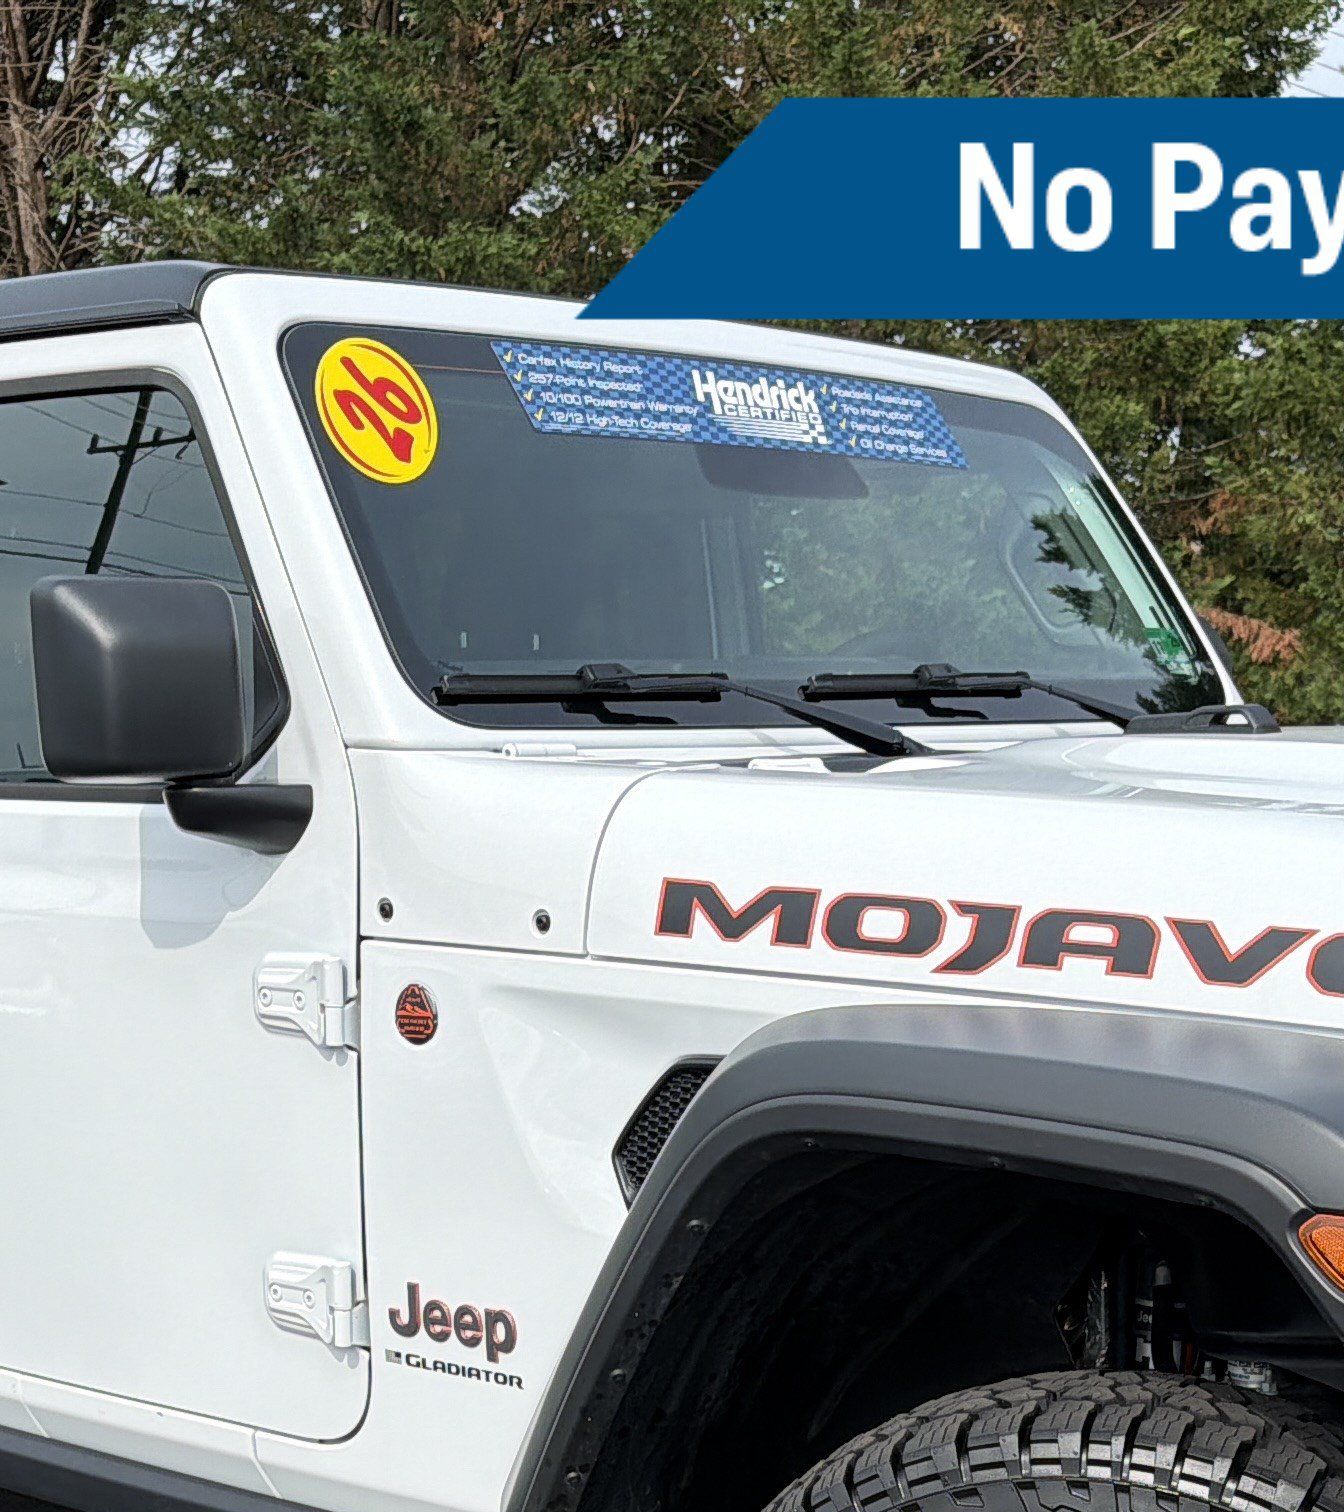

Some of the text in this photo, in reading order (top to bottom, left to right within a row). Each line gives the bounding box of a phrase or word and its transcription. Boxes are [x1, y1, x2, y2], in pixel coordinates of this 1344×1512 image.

[560, 358, 600, 372] History
[603, 361, 644, 375] Report
[333, 355, 422, 463] 26
[691, 369, 819, 415] Hendrick
[724, 403, 823, 425] CERTIFIED
[388, 1281, 517, 1365] Jeep
[405, 1353, 525, 1391] GLADIATOR
